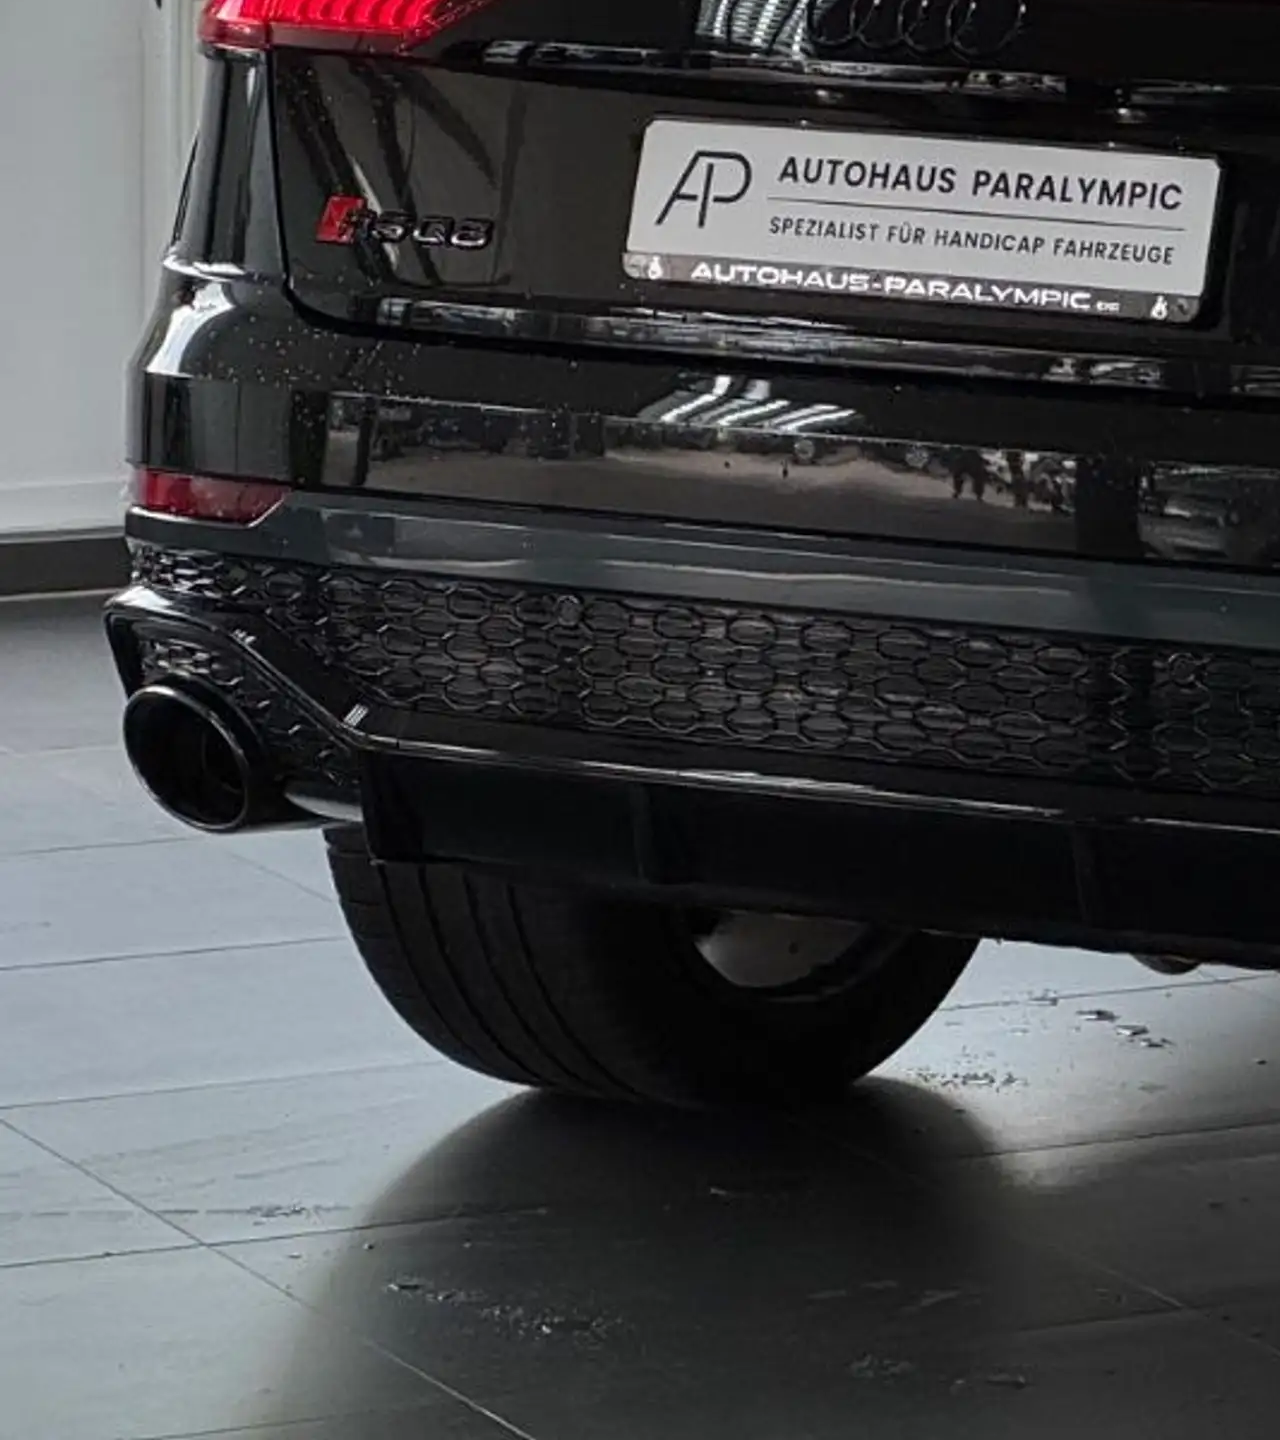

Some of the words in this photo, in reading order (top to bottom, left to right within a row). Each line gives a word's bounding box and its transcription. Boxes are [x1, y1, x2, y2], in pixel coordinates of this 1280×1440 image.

[654, 149, 753, 230] AP
[777, 156, 957, 194] AUTOHAUS
[971, 169, 1184, 212] PARALYMPIC
[768, 216, 880, 242] SPEZIALIST
[886, 221, 926, 245] FÜR
[933, 229, 1046, 255] HANDICAP
[1052, 237, 1176, 266] FAHRZEUGE
